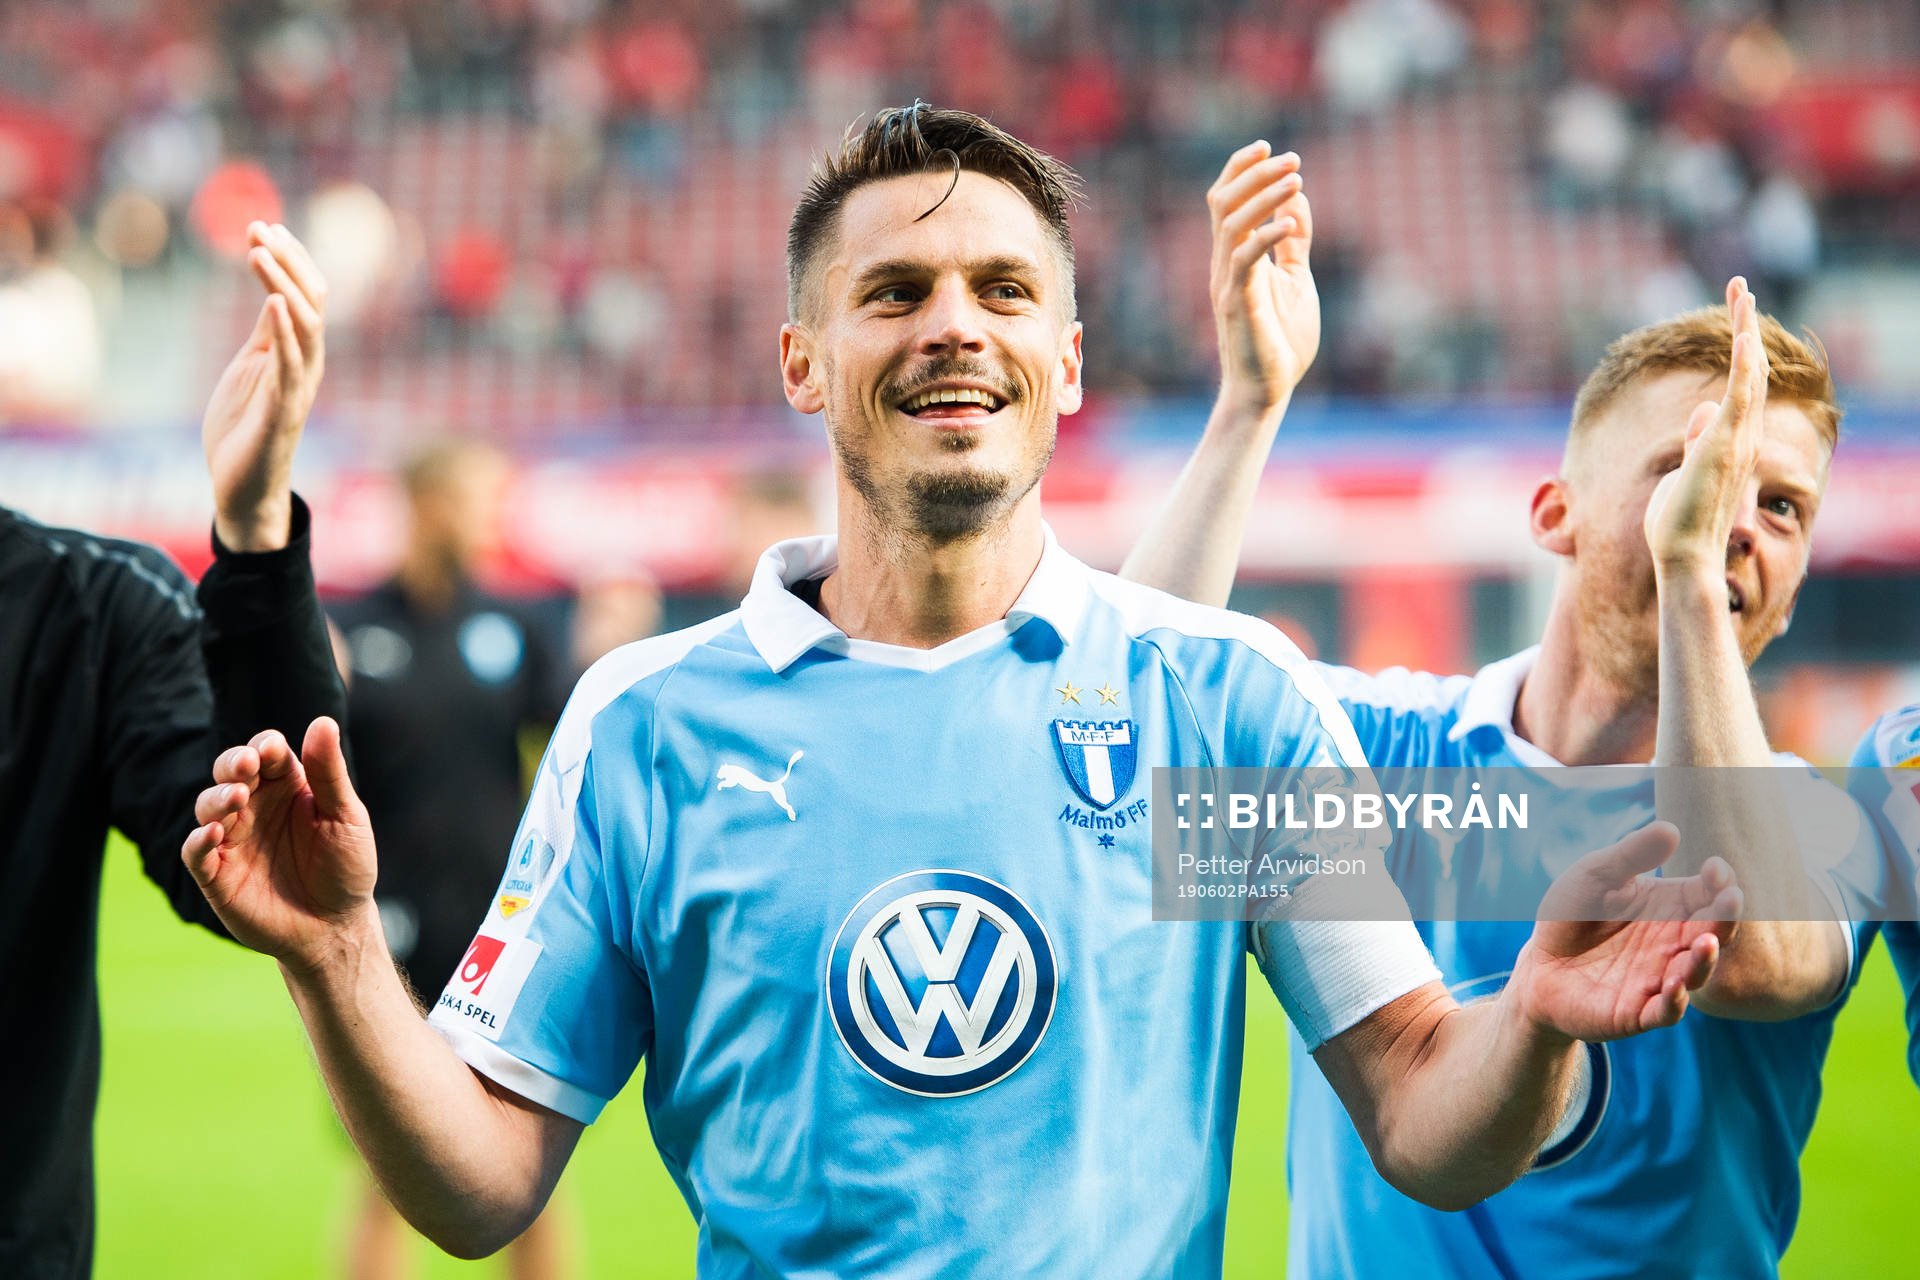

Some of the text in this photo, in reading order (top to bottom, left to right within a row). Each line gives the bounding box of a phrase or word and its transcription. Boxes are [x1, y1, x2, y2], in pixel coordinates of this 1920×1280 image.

[1058, 798, 1149, 830] Malmö FF
[464, 1004, 496, 1029] SPEL
